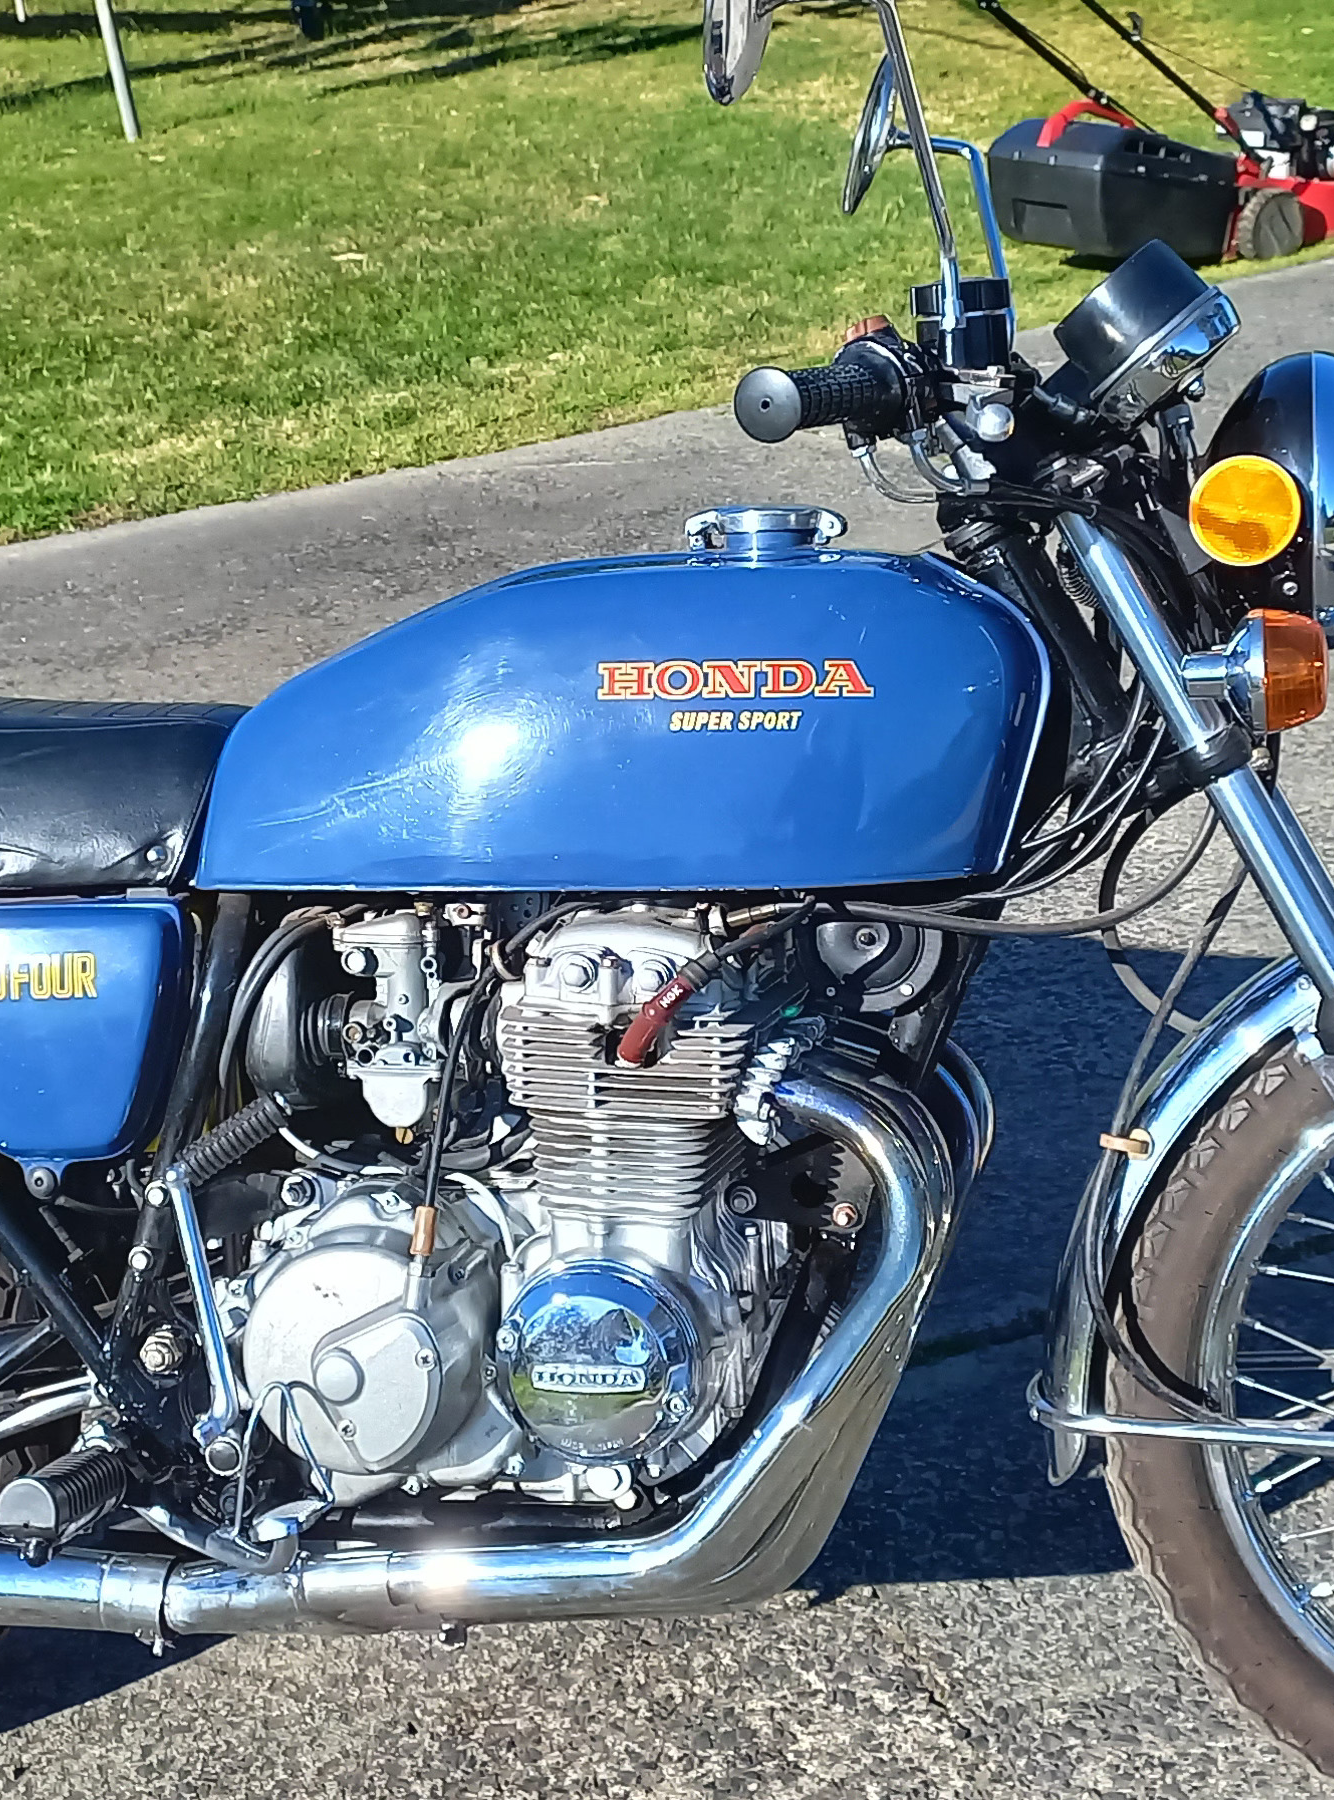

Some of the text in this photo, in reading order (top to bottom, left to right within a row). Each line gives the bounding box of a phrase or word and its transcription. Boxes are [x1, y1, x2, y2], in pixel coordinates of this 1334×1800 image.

[597, 659, 875, 701] HONDA
[669, 710, 803, 732] SUPER SPORT
[533, 1370, 640, 1387] HONDA
